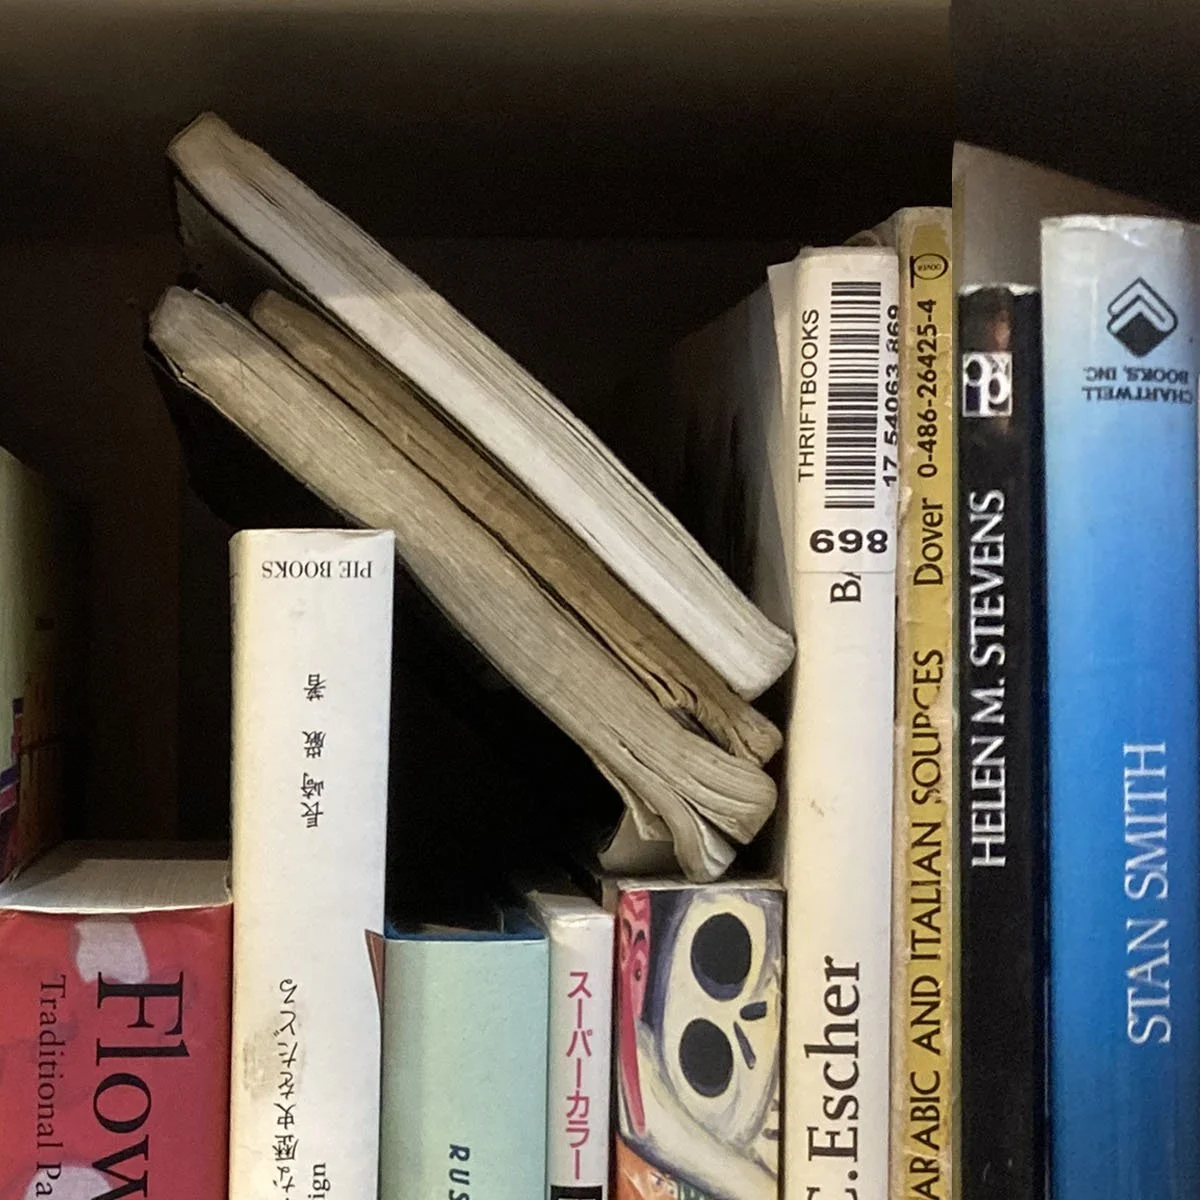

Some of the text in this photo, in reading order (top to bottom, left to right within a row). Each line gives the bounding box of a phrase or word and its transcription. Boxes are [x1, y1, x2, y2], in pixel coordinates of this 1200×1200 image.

[798, 309, 819, 482] THRIFTBOOKS
[885, 364, 899, 445] 54063
[1082, 385, 1193, 404] CHARTWELL
[1083, 367, 1189, 385] BOOKS, INC.
[883, 458, 897, 487] 17
[913, 299, 943, 586] Dover 0-486-26425-4
[261, 561, 373, 579] PIE BOOKS
[810, 529, 889, 554] 698
[304, 673, 327, 700] 著
[969, 489, 1006, 867] HELEN M. STEVENS
[301, 773, 325, 828] 長崎
[911, 822, 942, 960] ITALIAN
[1123, 742, 1170, 1044] STAN SMITH
[911, 974, 941, 1055] AND
[36, 975, 66, 1150] Traditional
[566, 971, 593, 1180] スーパーカラー
[910, 1070, 941, 1200] ARABIC
